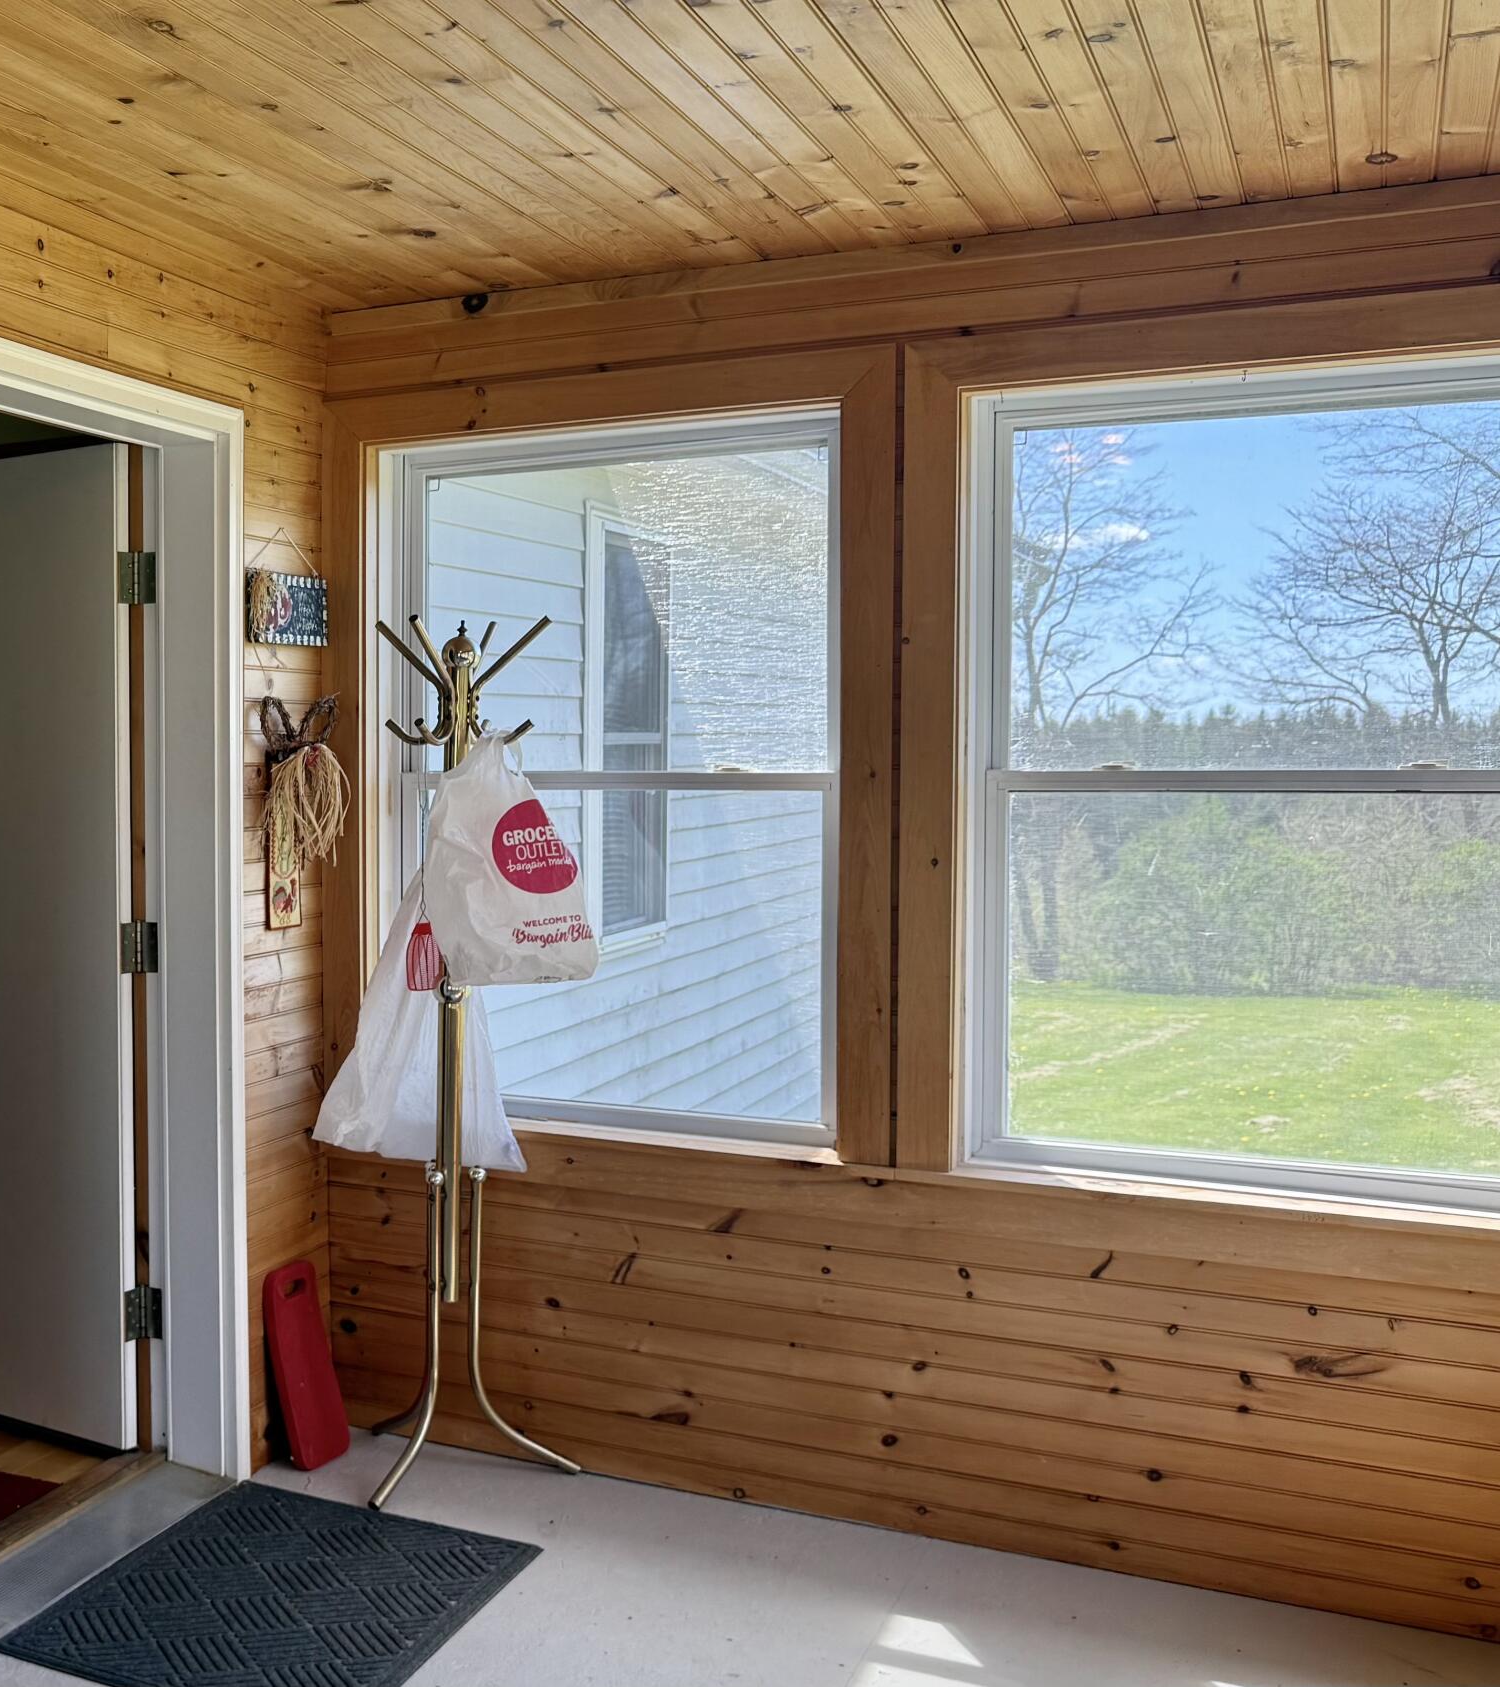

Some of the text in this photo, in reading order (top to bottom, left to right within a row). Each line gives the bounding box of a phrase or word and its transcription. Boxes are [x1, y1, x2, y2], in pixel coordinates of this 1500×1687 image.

[515, 840, 563, 860] OUTLET
[506, 859, 547, 874] bargain
[523, 914, 581, 928] WELCOME TO
[512, 927, 568, 948] Bargain
